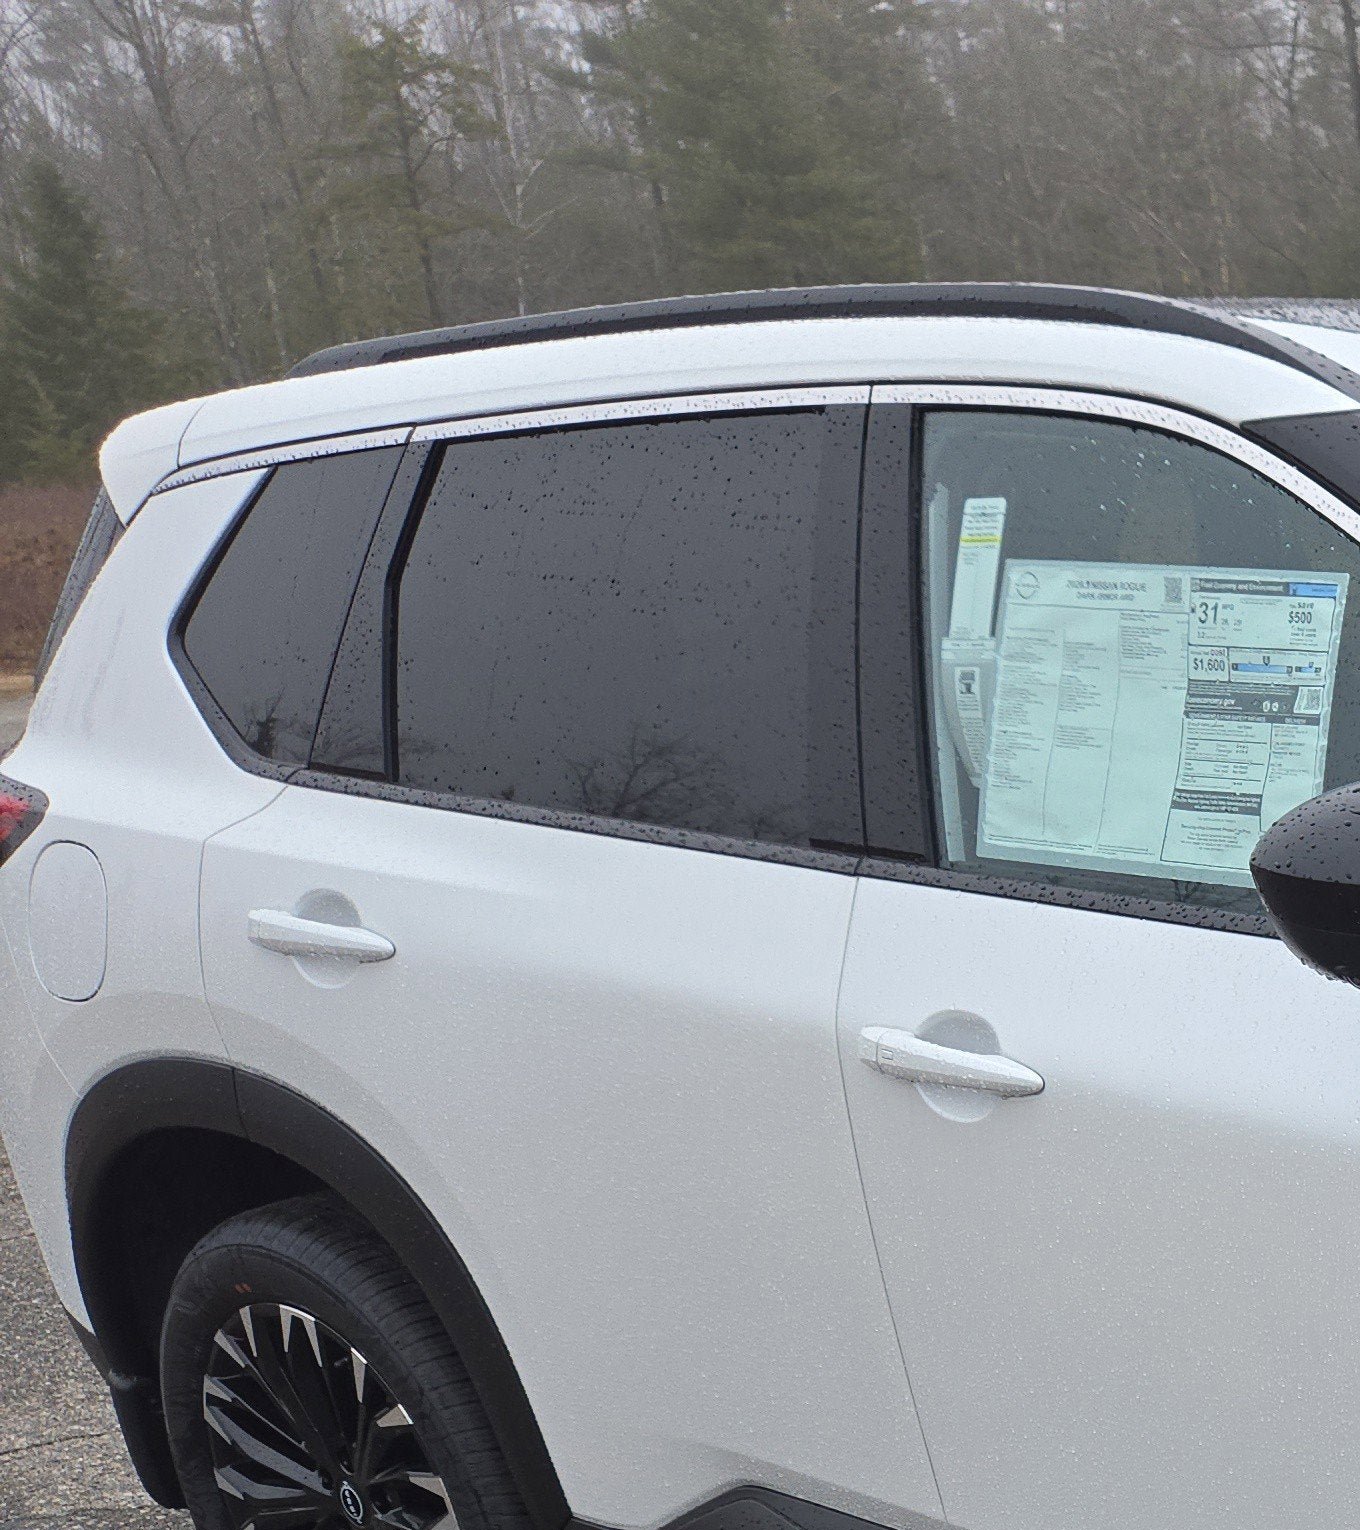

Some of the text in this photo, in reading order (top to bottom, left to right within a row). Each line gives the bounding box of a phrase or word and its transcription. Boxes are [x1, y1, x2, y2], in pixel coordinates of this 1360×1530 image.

[1198, 601, 1219, 625] 31
[1288, 610, 1312, 624] $500
[1193, 657, 1226, 672] $1,600
